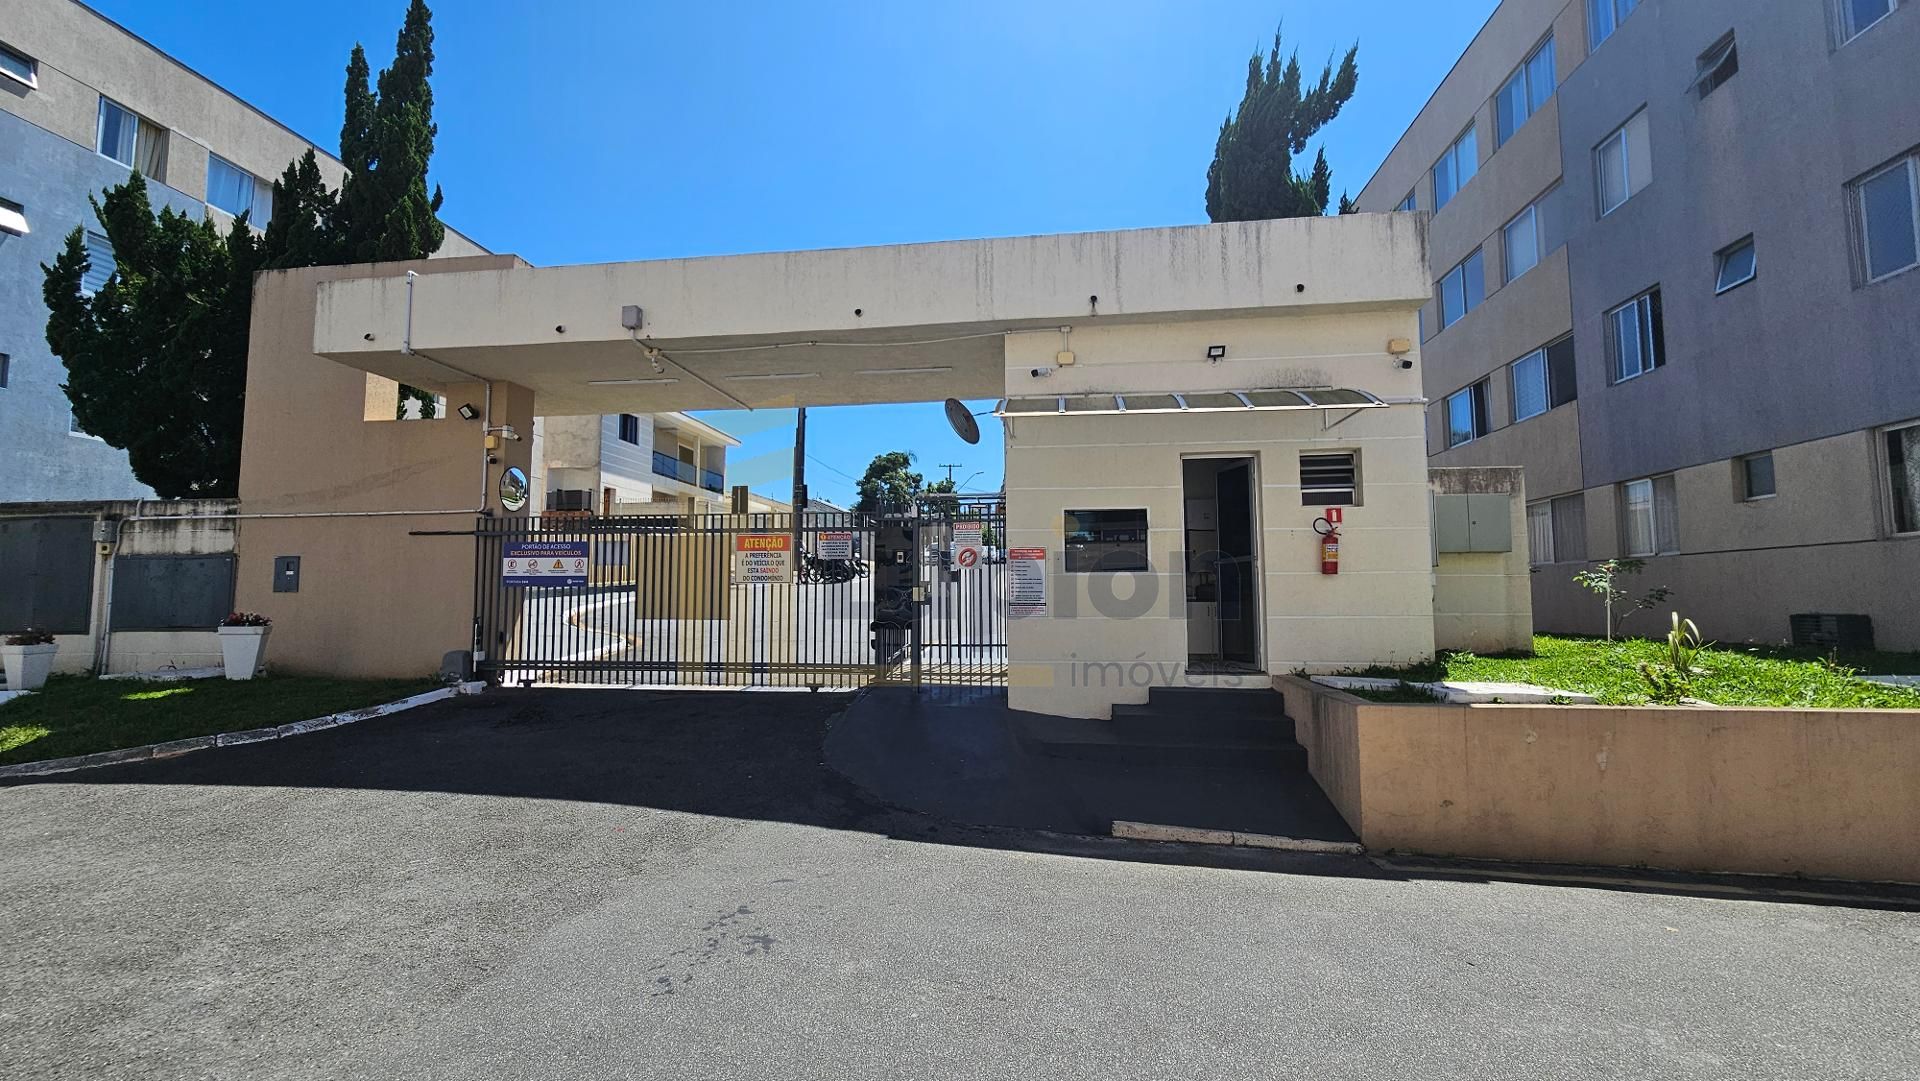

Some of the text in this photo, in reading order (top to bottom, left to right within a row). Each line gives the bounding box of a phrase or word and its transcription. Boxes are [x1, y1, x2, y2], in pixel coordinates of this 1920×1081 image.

[521, 542, 541, 550] PORTÃO
[744, 536, 784, 551] ATENÇÃO
[741, 558, 744, 566] É
[753, 558, 774, 566] VEÍCULO
[751, 573, 784, 582] CONDOMÍNIO
